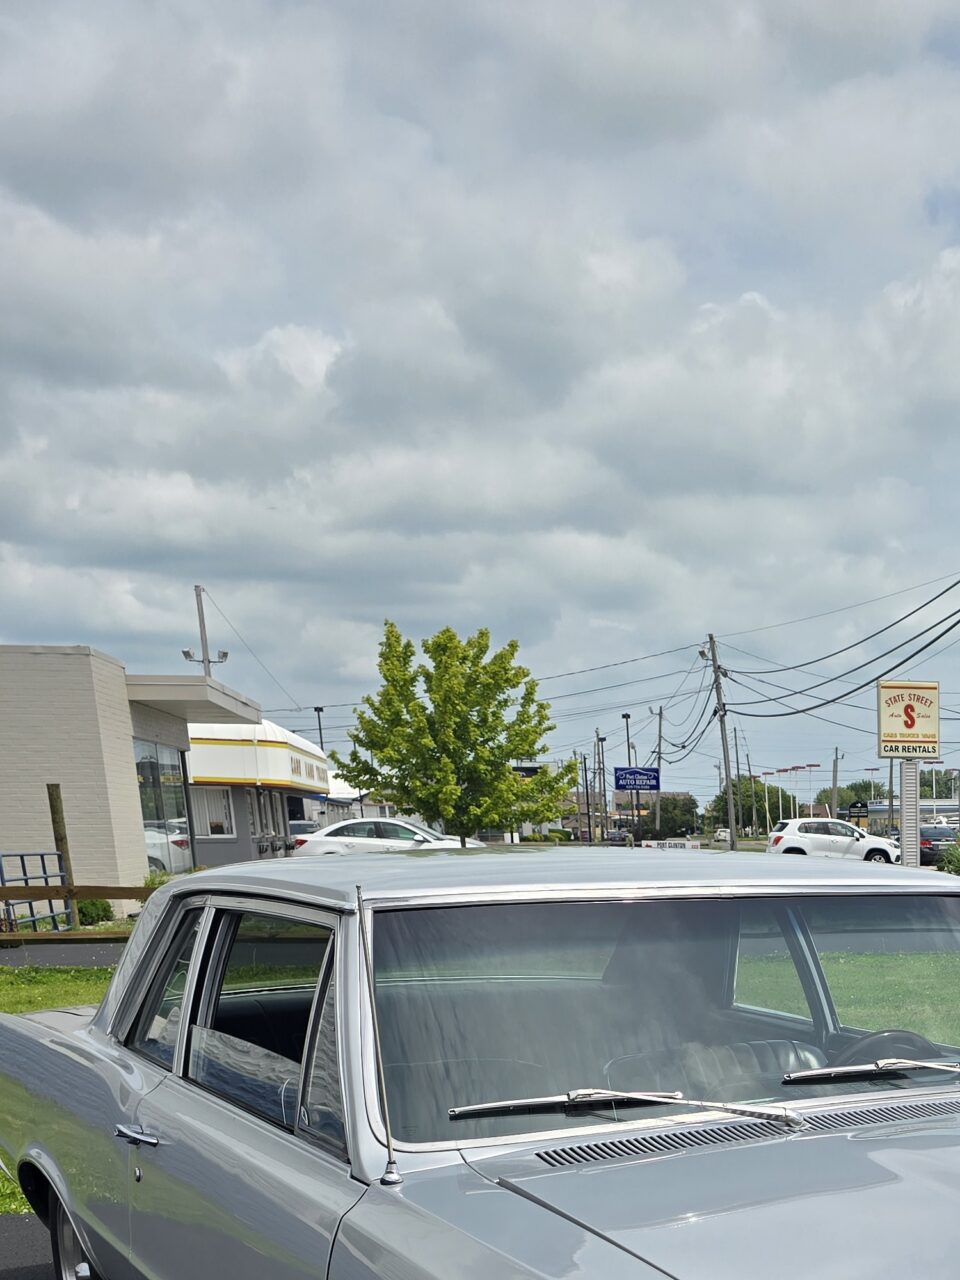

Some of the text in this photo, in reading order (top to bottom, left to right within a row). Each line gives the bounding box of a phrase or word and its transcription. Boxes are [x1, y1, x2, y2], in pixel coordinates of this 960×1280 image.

[885, 693, 934, 708] STATE STREET
[904, 704, 916, 728] S
[884, 744, 936, 754] CAR RENTALS
